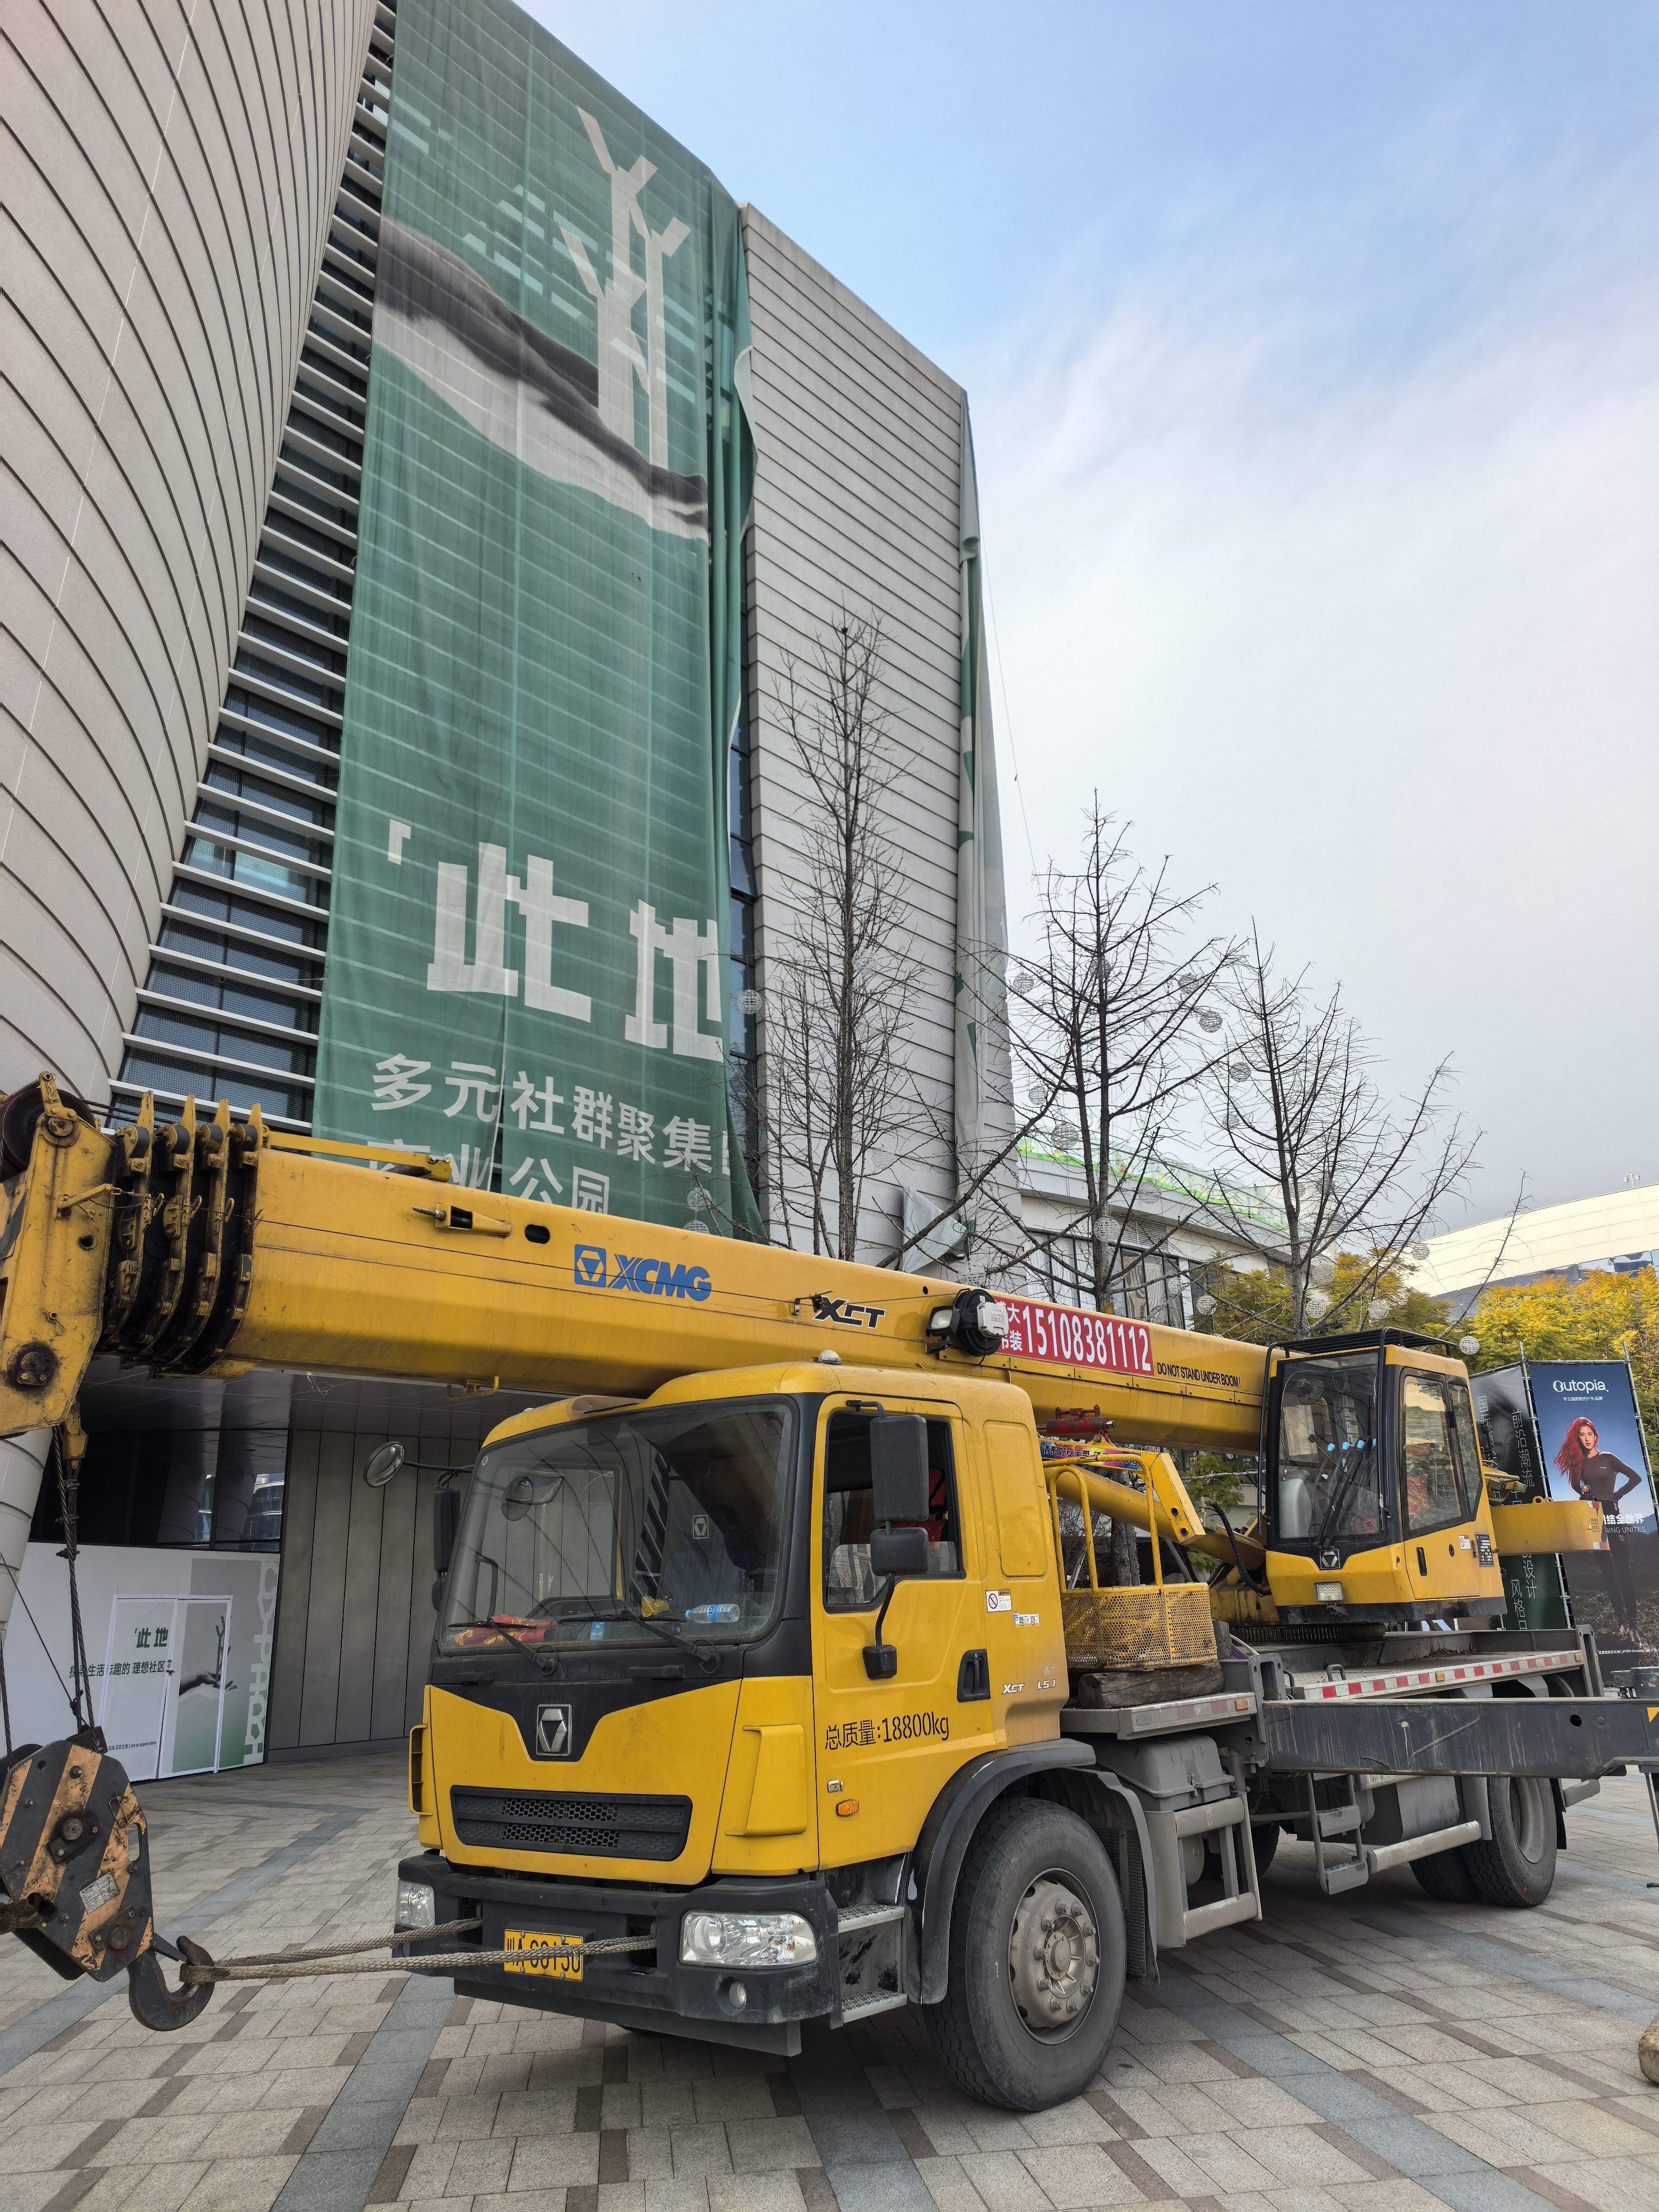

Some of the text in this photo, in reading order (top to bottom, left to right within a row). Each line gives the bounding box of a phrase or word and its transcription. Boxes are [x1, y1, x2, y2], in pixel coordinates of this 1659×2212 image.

[372, 1053, 729, 1176] 多元社群聚集
[606, 1253, 712, 1301] XCMG
[812, 1297, 886, 1329] XCT
[1022, 1305, 1151, 1372] 15108381112
[1157, 1362, 1167, 1375] DO
[1167, 1364, 1180, 1377] NOT
[1181, 1366, 1201, 1381] STAND
[1201, 1370, 1221, 1385] UNDER
[1603, 1514, 1644, 1525] 结全世界
[1522, 1554, 1537, 1599] 设计
[132, 1661, 165, 1674] 理想社区
[1002, 1683, 1024, 1695] XCT
